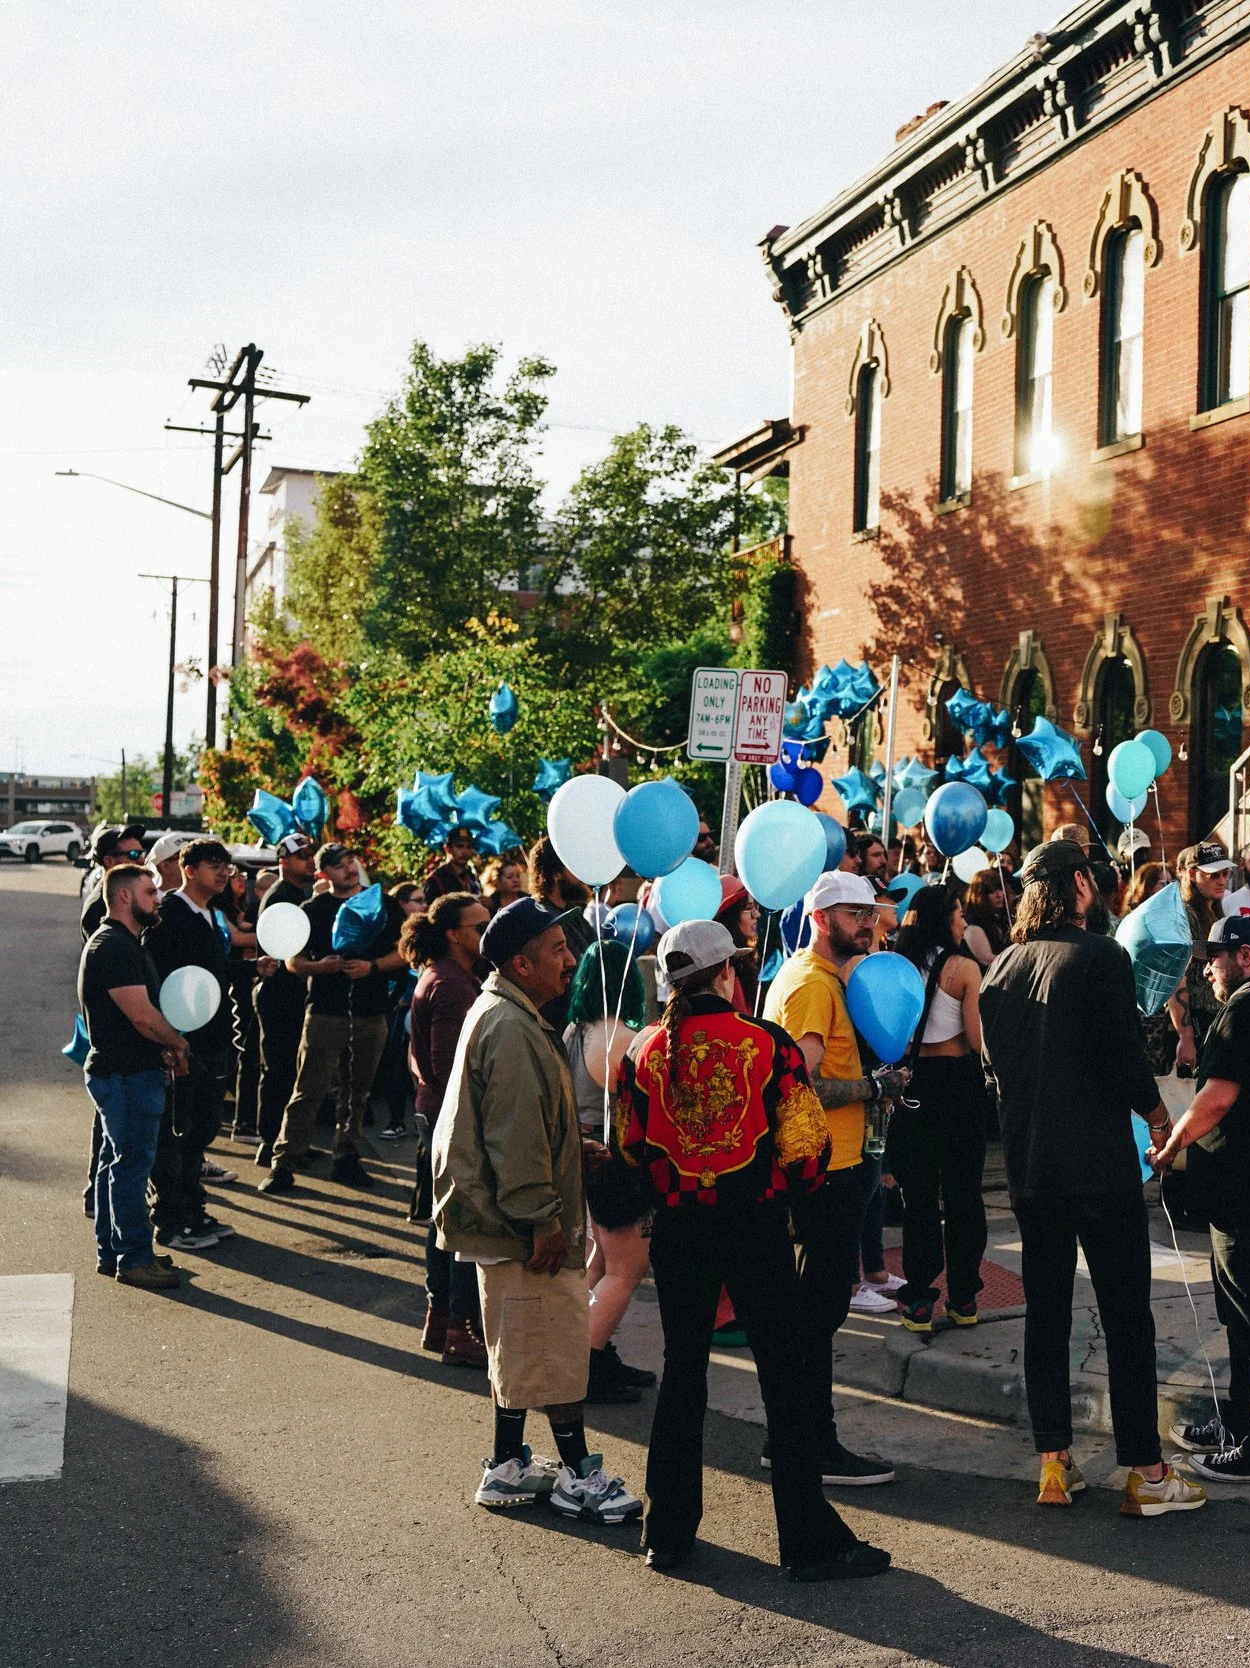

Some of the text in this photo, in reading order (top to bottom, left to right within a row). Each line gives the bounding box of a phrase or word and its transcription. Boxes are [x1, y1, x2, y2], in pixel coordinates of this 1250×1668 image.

[697, 677, 735, 690] LOADING
[753, 677, 772, 694] NO
[703, 696, 726, 709] ONLY
[741, 695, 782, 714] PARKING
[749, 715, 769, 727] ANY
[747, 727, 768, 741] TIME
